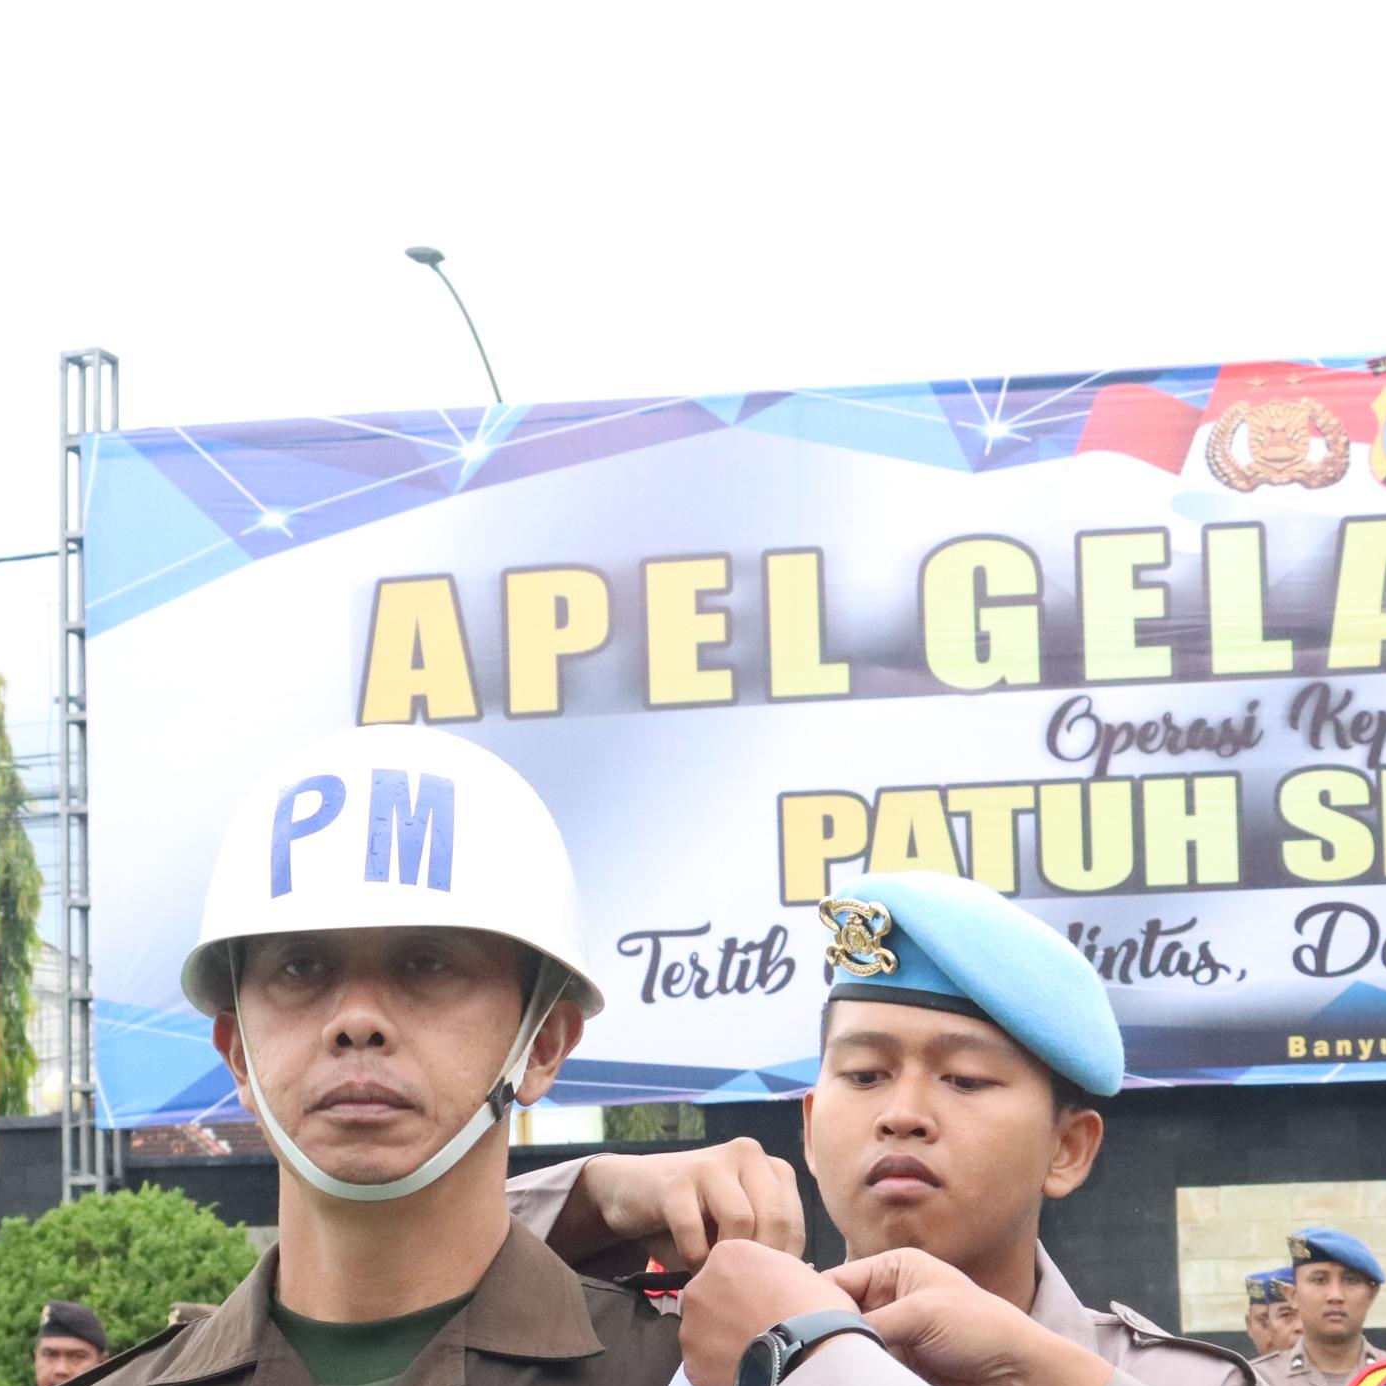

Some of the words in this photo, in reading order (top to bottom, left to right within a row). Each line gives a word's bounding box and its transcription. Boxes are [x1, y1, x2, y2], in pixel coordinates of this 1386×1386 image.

[356, 546, 851, 727] APEL
[1046, 694, 1263, 777] Operasi
[270, 768, 455, 899] PM
[778, 769, 1242, 906] PATUH
[617, 921, 795, 1003] Tertib
